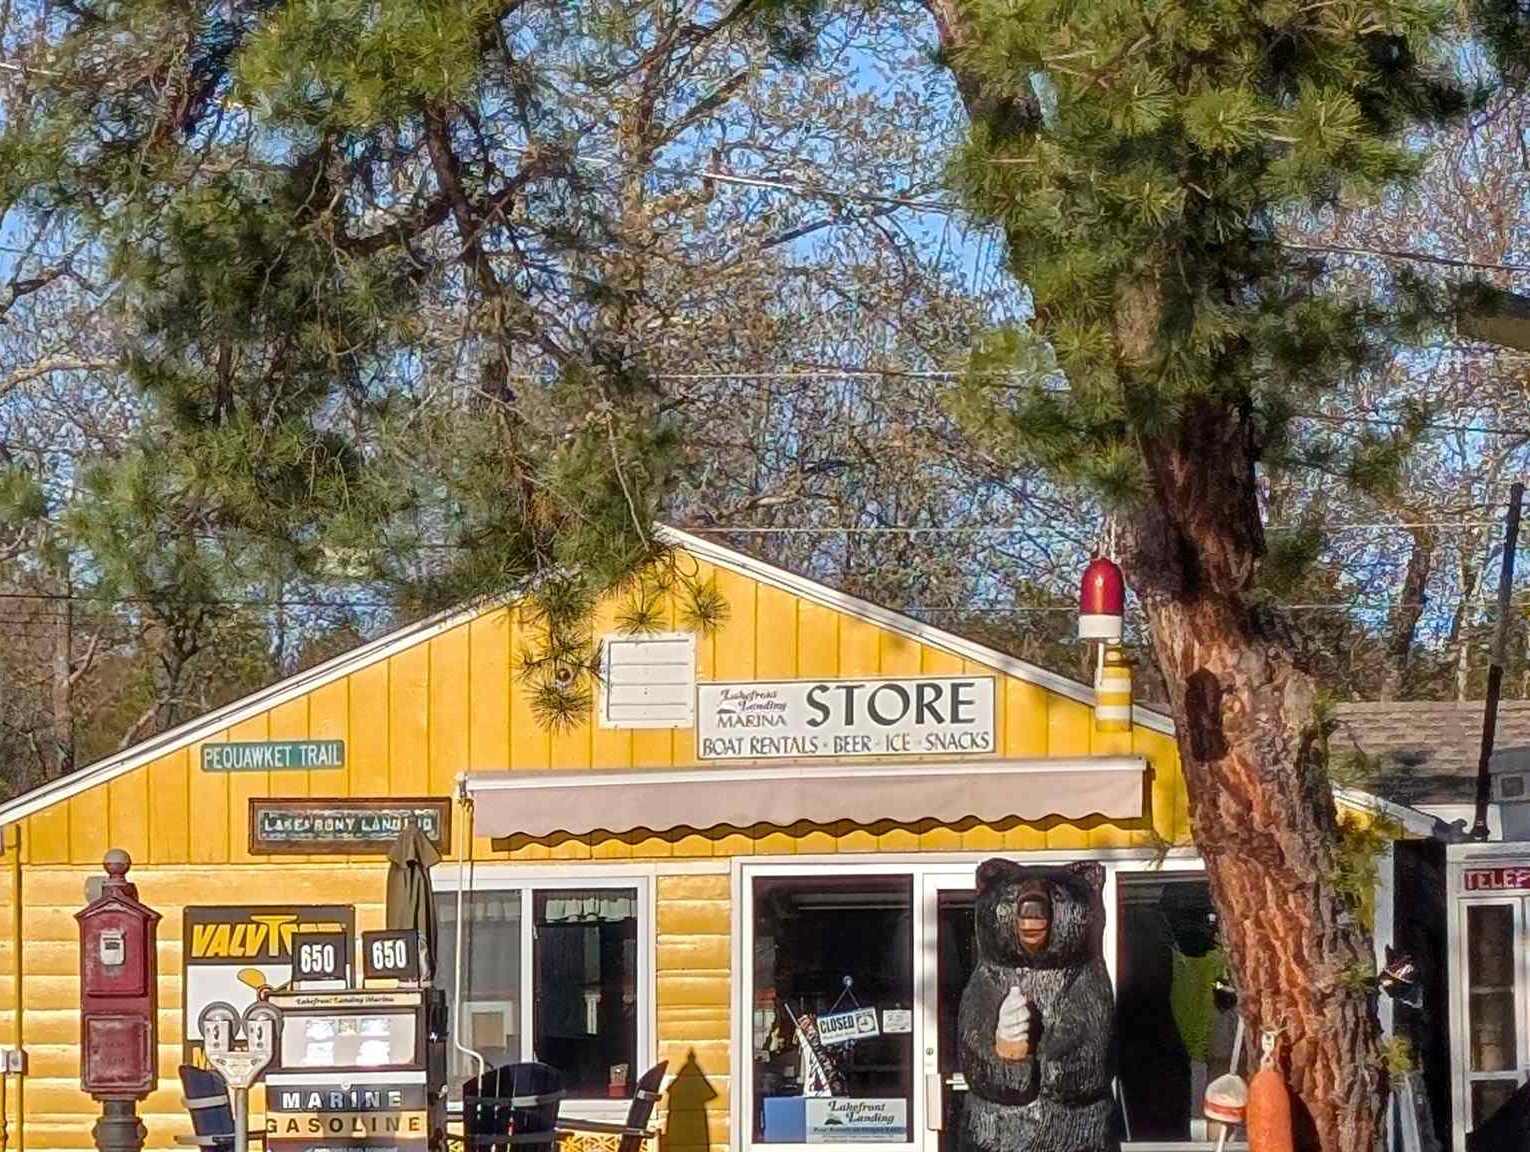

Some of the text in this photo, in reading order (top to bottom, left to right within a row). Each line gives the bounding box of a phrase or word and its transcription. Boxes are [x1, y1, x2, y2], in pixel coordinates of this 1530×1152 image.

[738, 700, 787, 711] Landing
[805, 682, 975, 727] STORE
[717, 714, 787, 728] MARINA
[703, 731, 990, 756] BOAT RENTALS BEER ICE SNACKS
[204, 744, 342, 769] PEQUAWKET TRAIL
[301, 944, 334, 973] 650
[372, 940, 406, 970] 650
[820, 1015, 855, 1034] CLOSED
[282, 1091, 402, 1109] MARINE
[828, 1101, 886, 1113] Lakefront
[266, 1117, 420, 1134] GASOLINE
[846, 1112, 894, 1124] Landing
